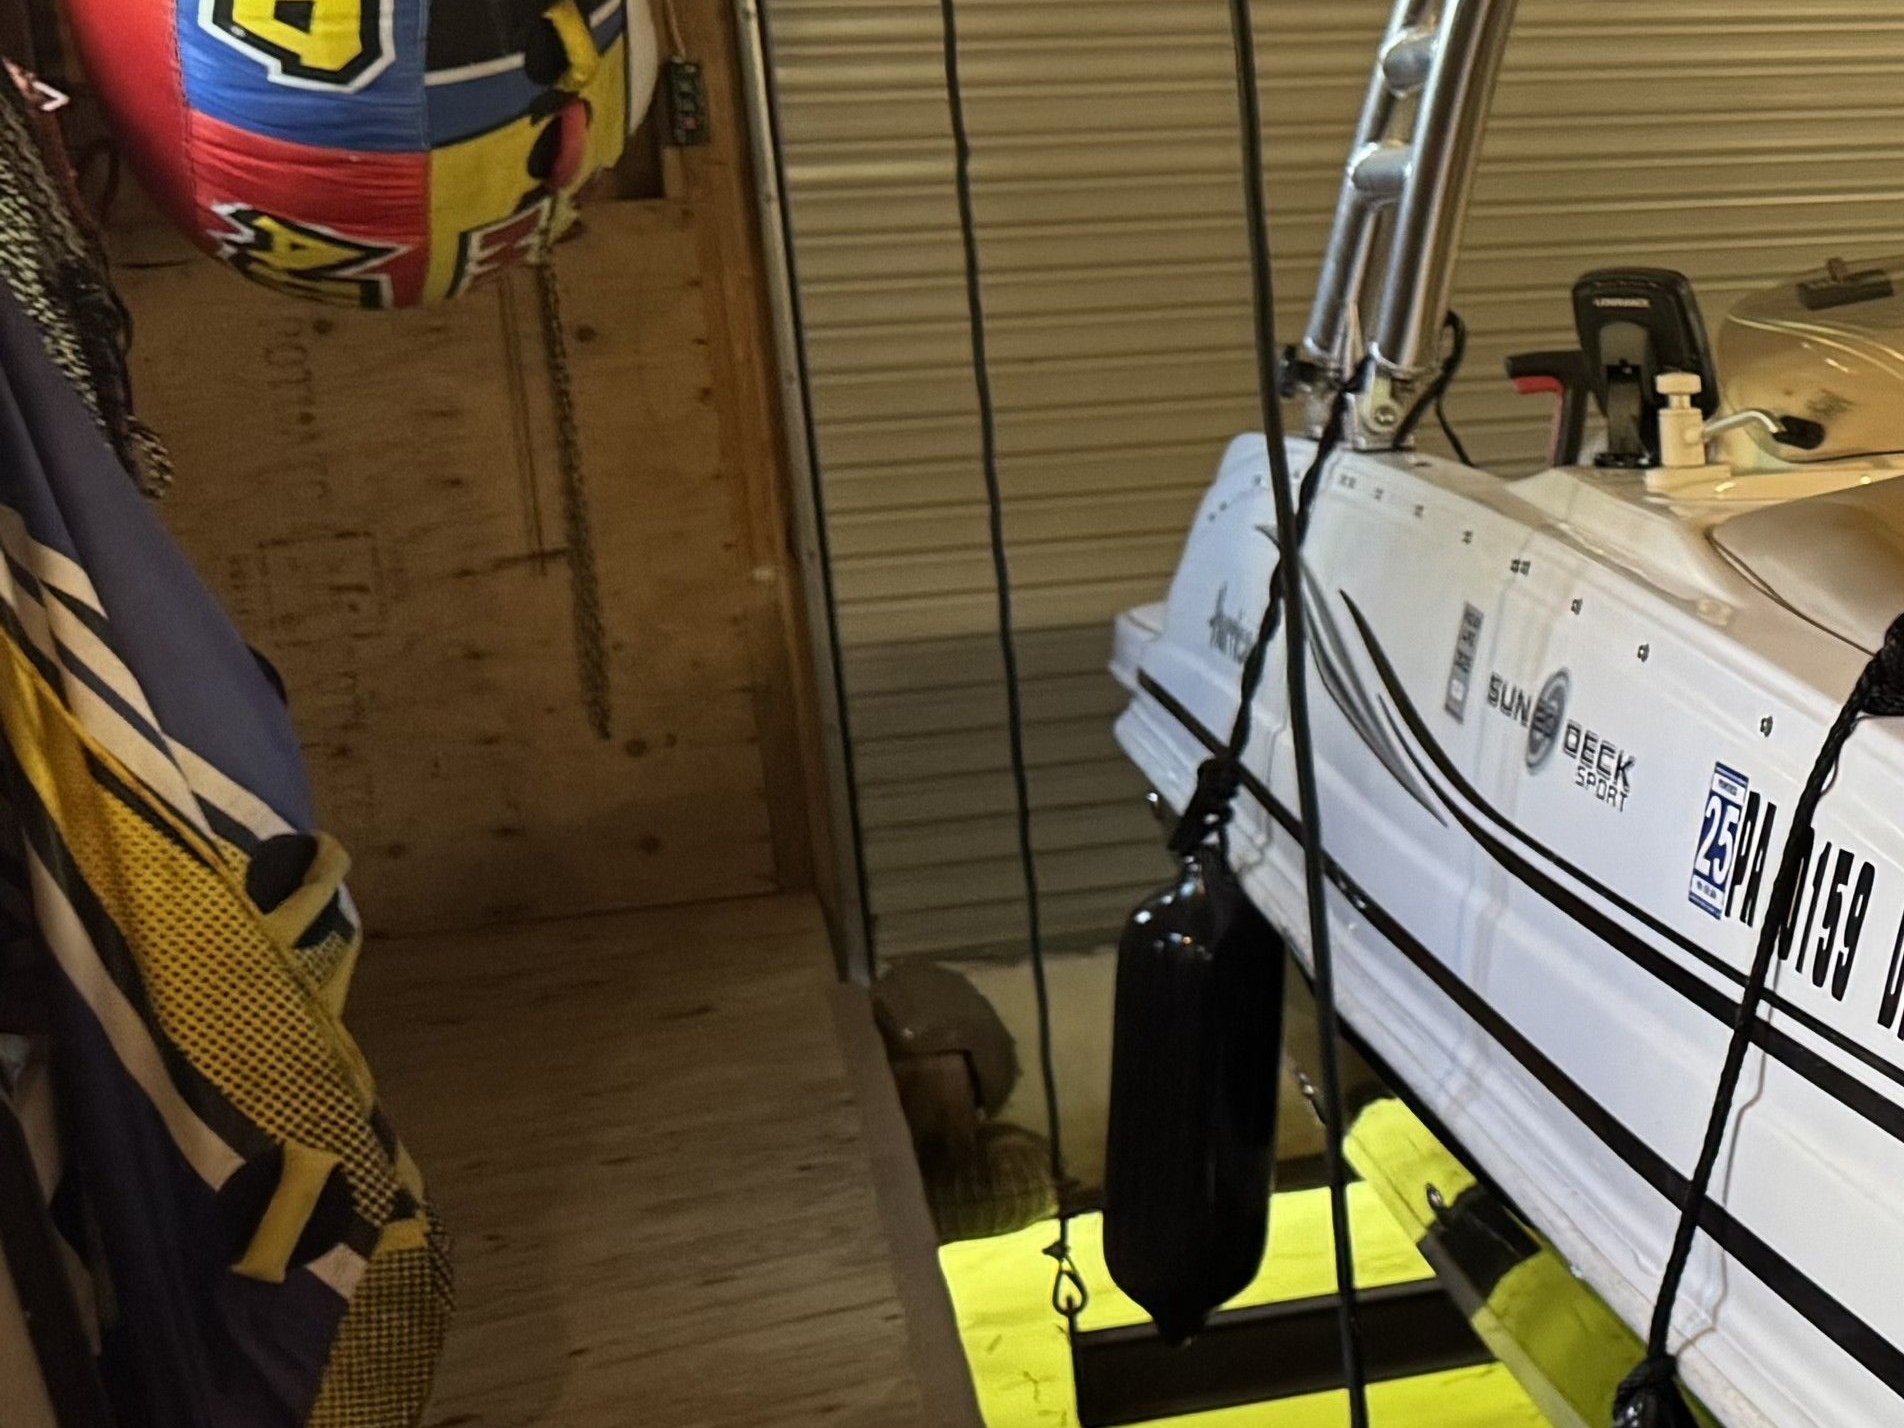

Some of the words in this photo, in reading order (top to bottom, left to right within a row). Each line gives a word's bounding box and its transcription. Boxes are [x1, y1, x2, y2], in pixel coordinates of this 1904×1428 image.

[1486, 672, 1532, 728] SUN
[1564, 721, 1635, 789] DECK
[1576, 765, 1628, 813] SPORT
[1695, 796, 1740, 884] 25
[1724, 790, 1777, 928] PA
